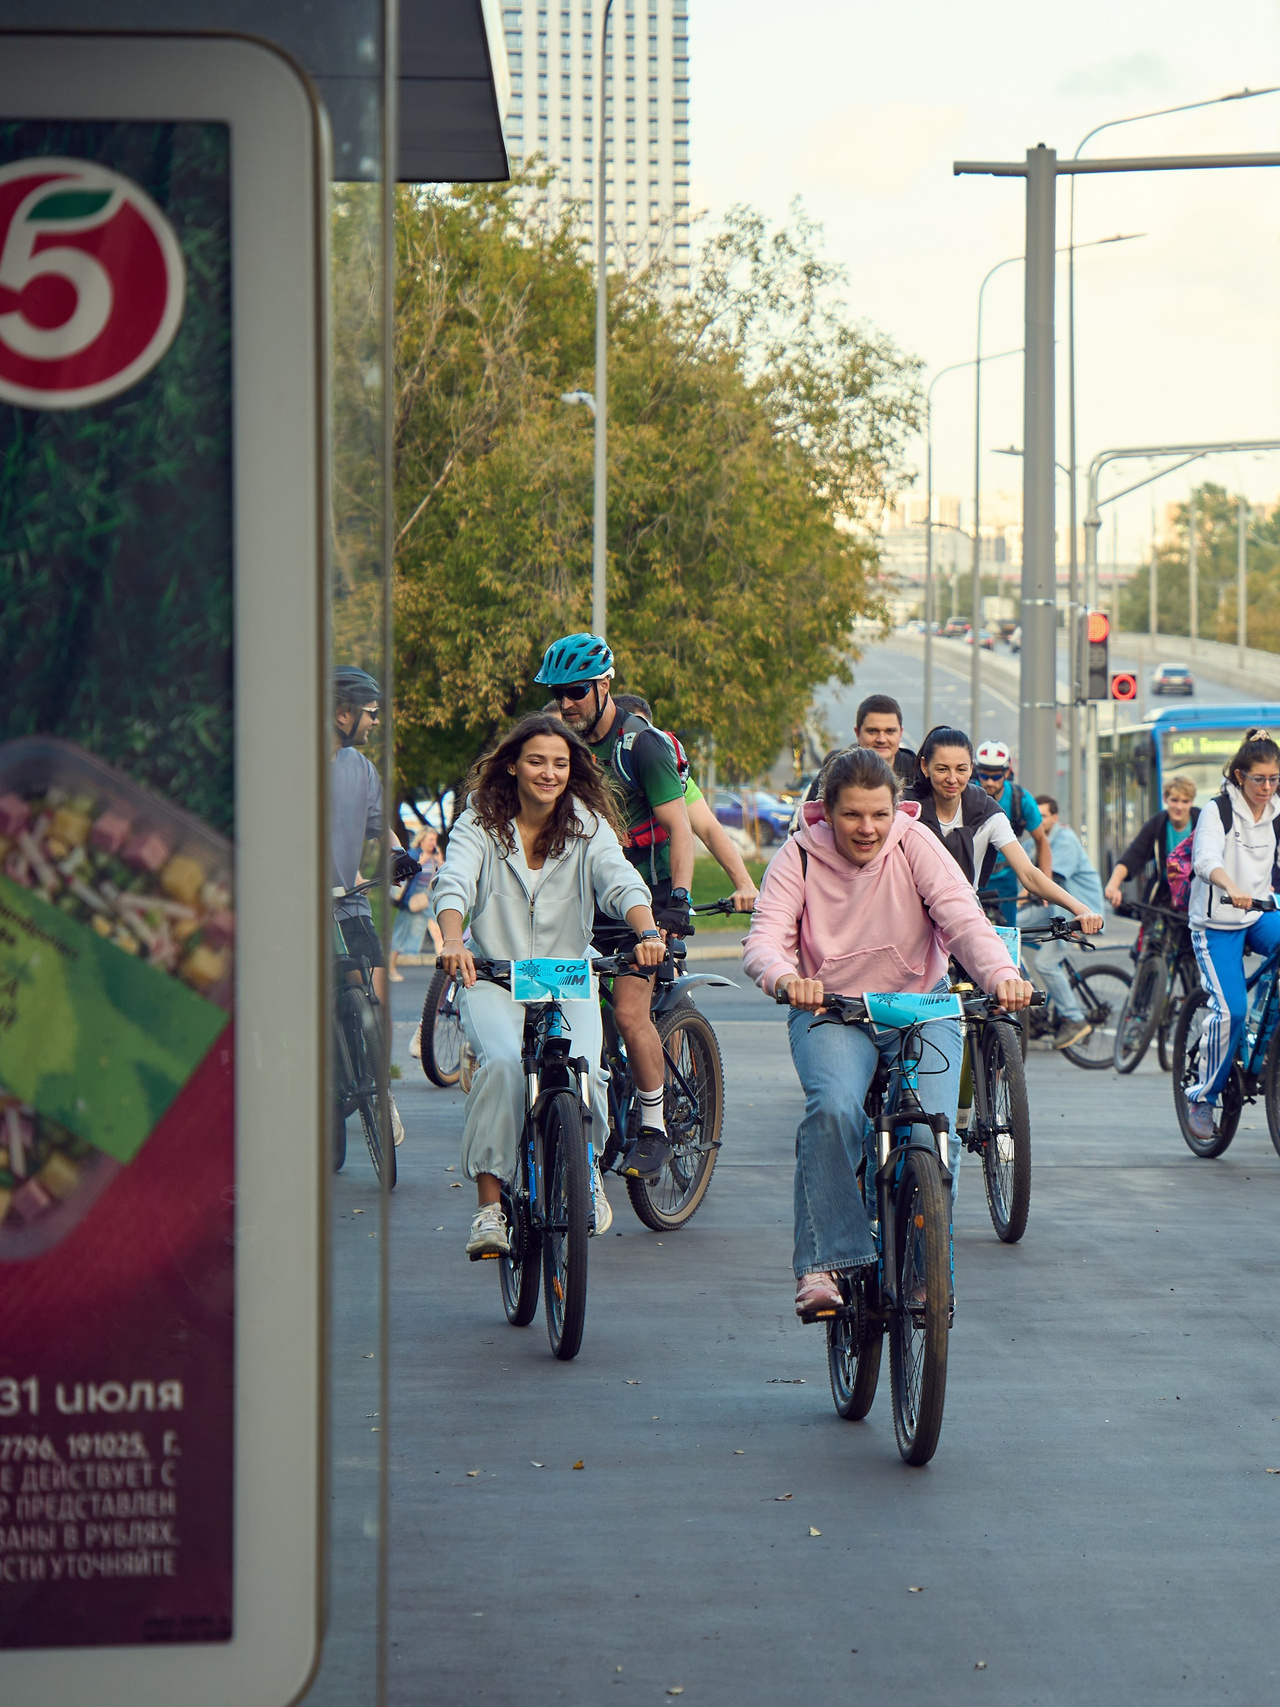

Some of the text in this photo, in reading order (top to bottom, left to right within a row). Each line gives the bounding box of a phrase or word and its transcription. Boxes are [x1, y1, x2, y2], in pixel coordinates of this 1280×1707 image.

[20, 1460, 155, 1493] ДЕЙСТВУЕТ
[16, 1488, 177, 1523] ПРЕДСТАВЛЕН
[63, 1521, 79, 1550] В
[0, 1547, 177, 1582] СТИ УТОЧНЯЙТЕ
